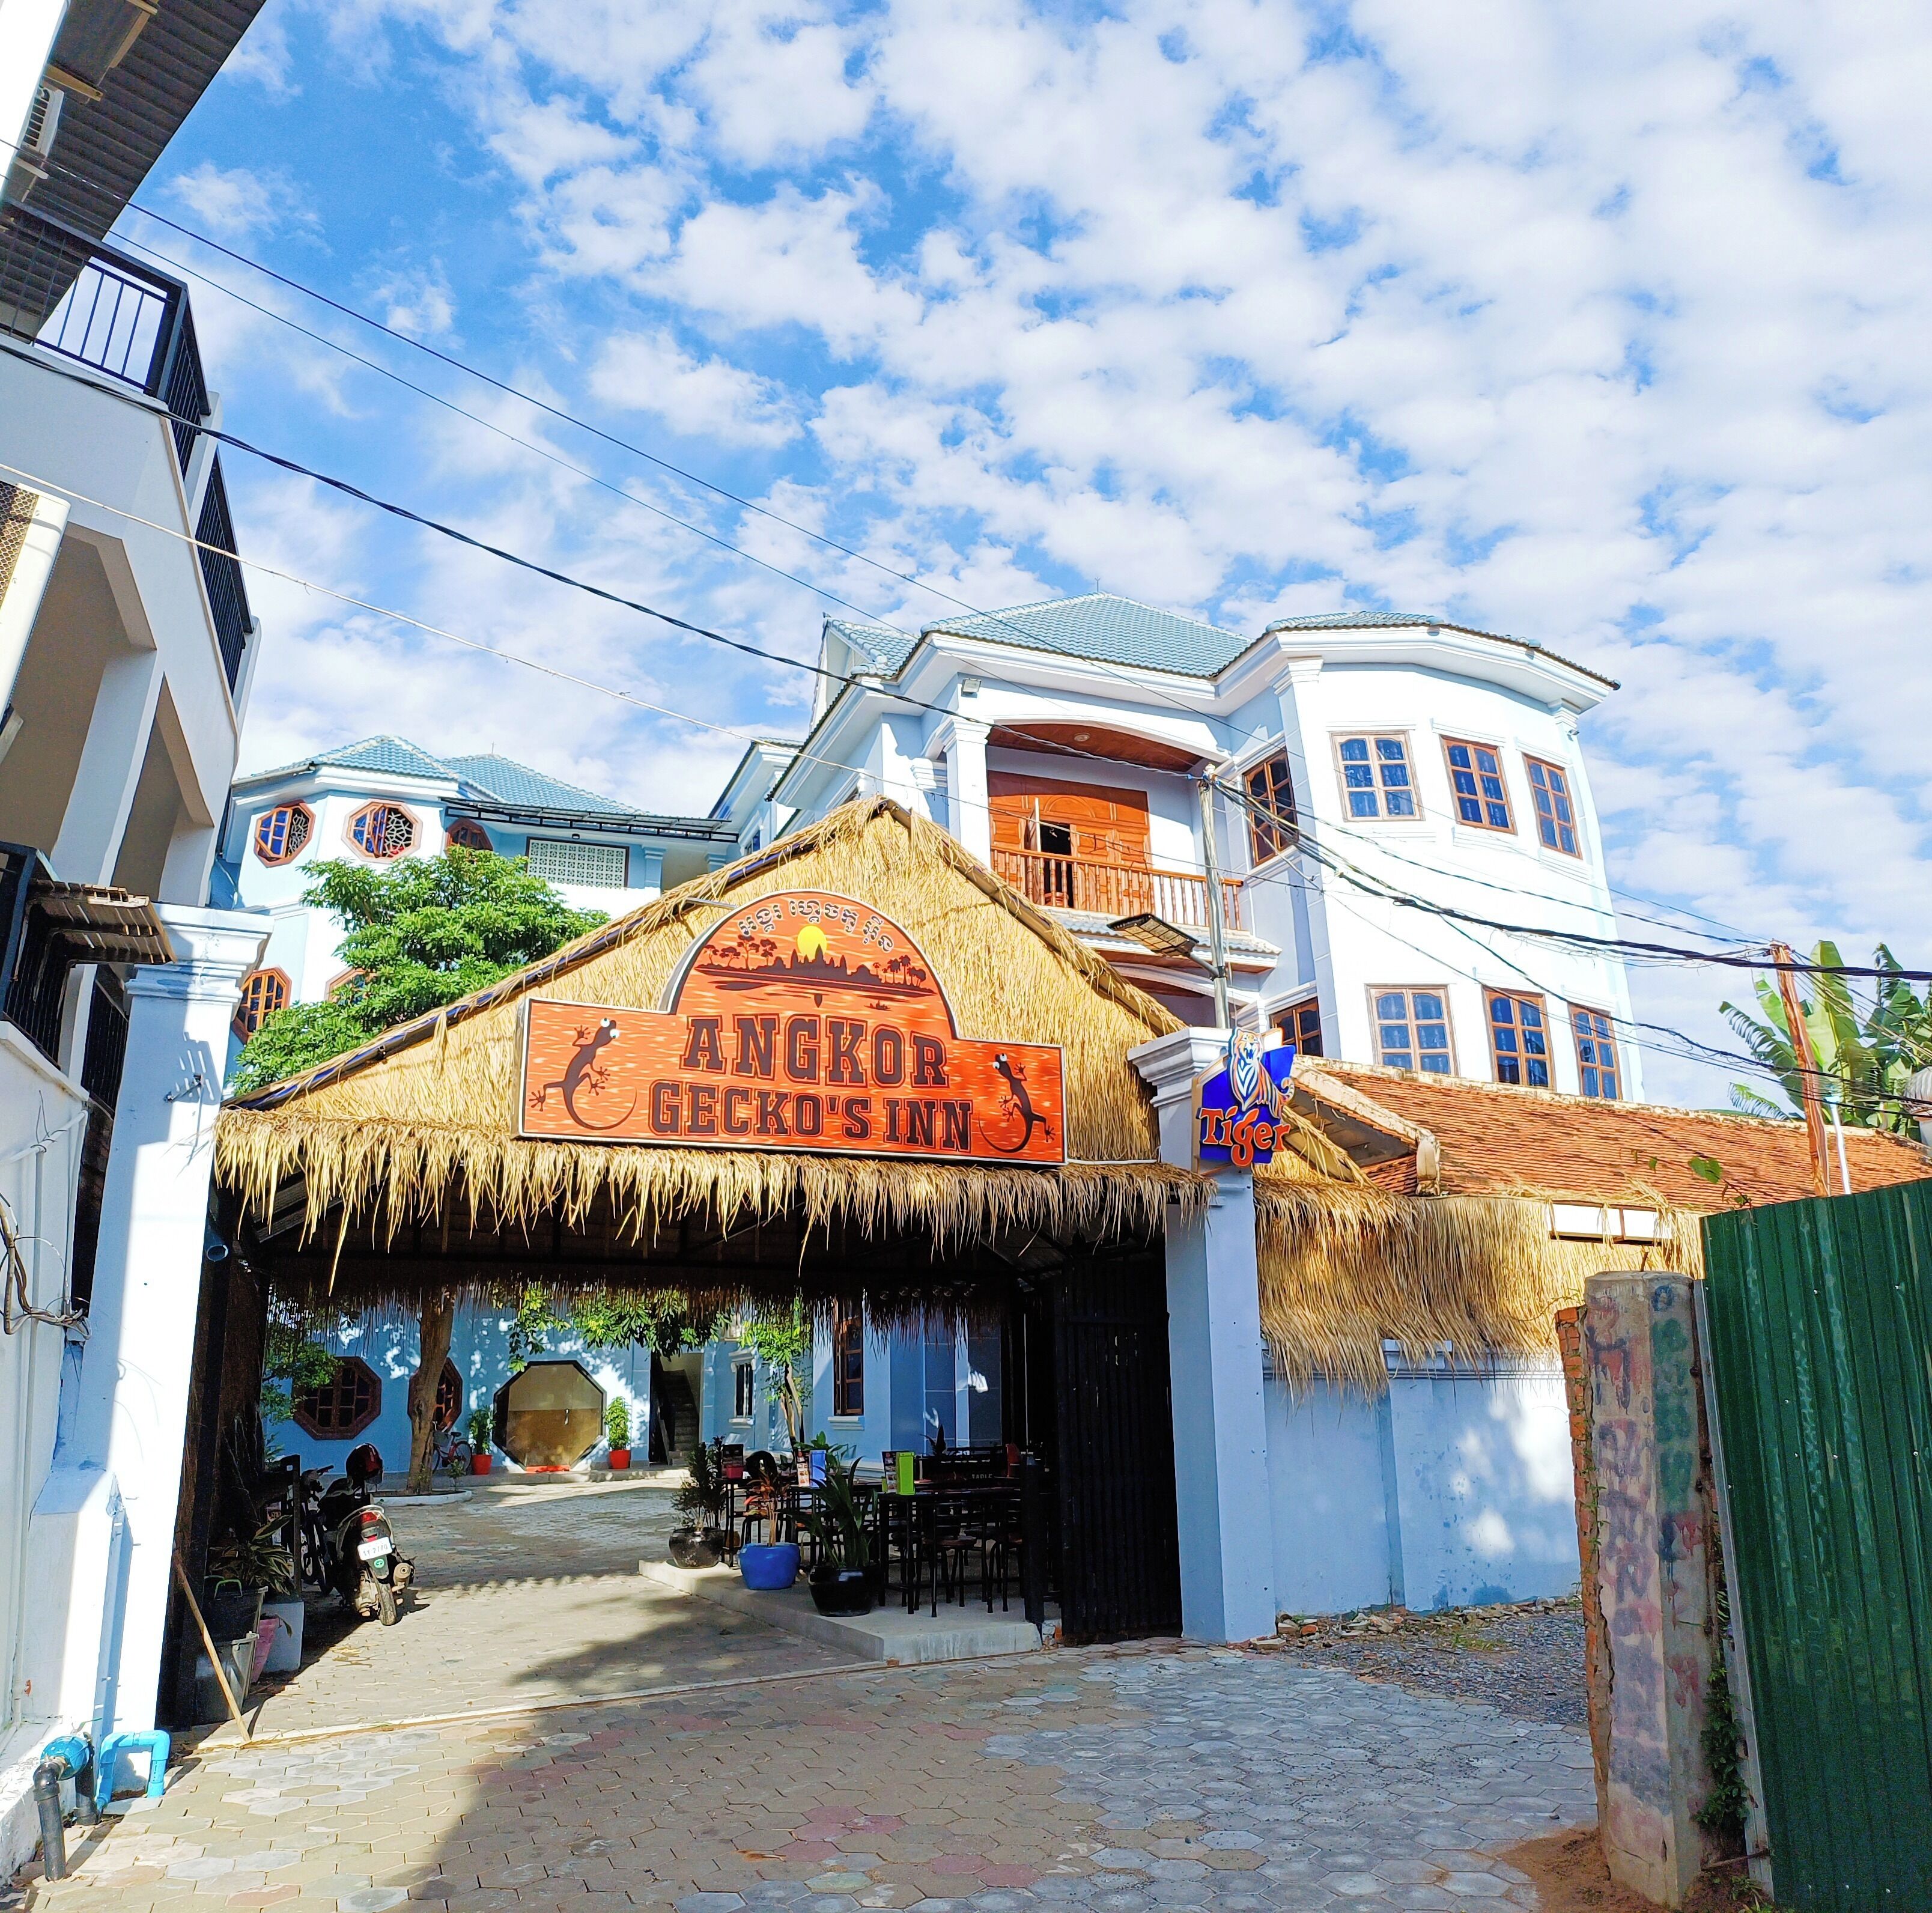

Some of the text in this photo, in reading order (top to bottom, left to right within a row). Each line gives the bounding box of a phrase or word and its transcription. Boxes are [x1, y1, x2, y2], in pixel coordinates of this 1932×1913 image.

[679, 1013, 949, 1089] ANGKOR
[648, 1080, 974, 1153] GECKO'S INN
[1200, 1106, 1291, 1167] Tiger
